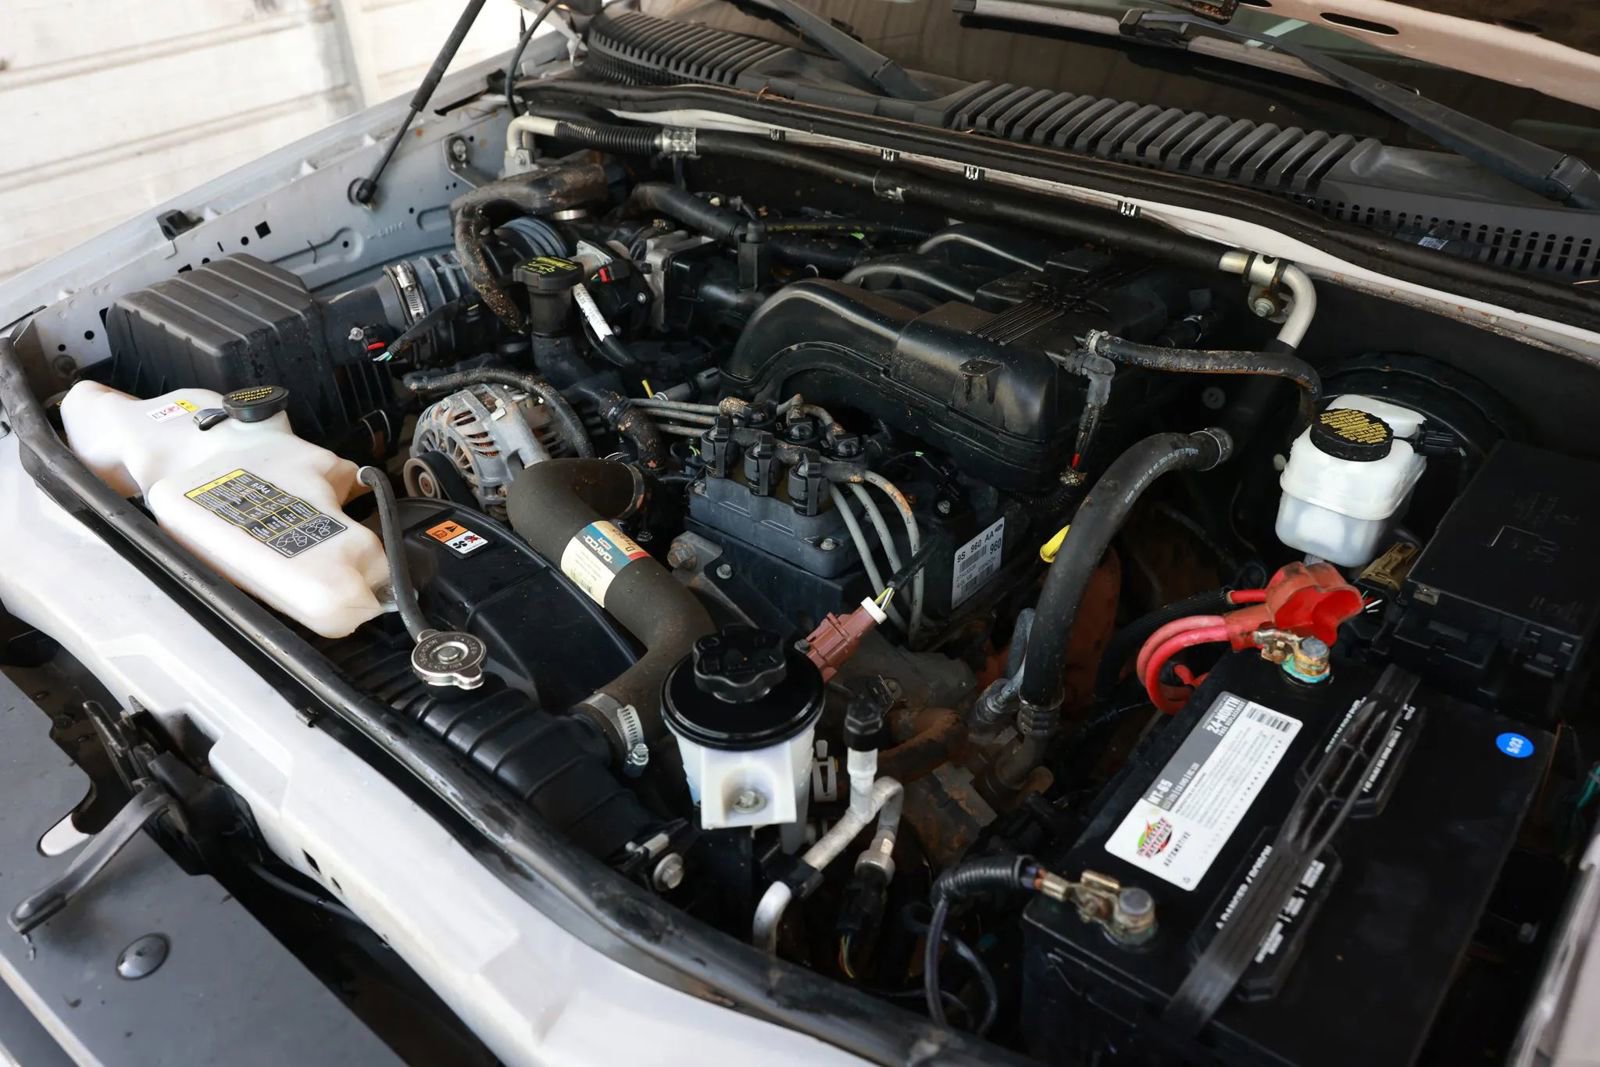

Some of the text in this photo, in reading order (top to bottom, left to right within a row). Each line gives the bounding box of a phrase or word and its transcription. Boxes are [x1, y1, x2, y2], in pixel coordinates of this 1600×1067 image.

[585, 535, 612, 561] DAYCO
[985, 531, 994, 542] AA
[990, 538, 1002, 554] 960
[1206, 696, 1241, 735] 24-MONTH
[1137, 817, 1166, 856] INTERSTATE
[1145, 823, 1173, 859] BATTERIES
[1164, 831, 1191, 867] AUTOMOTIVE
